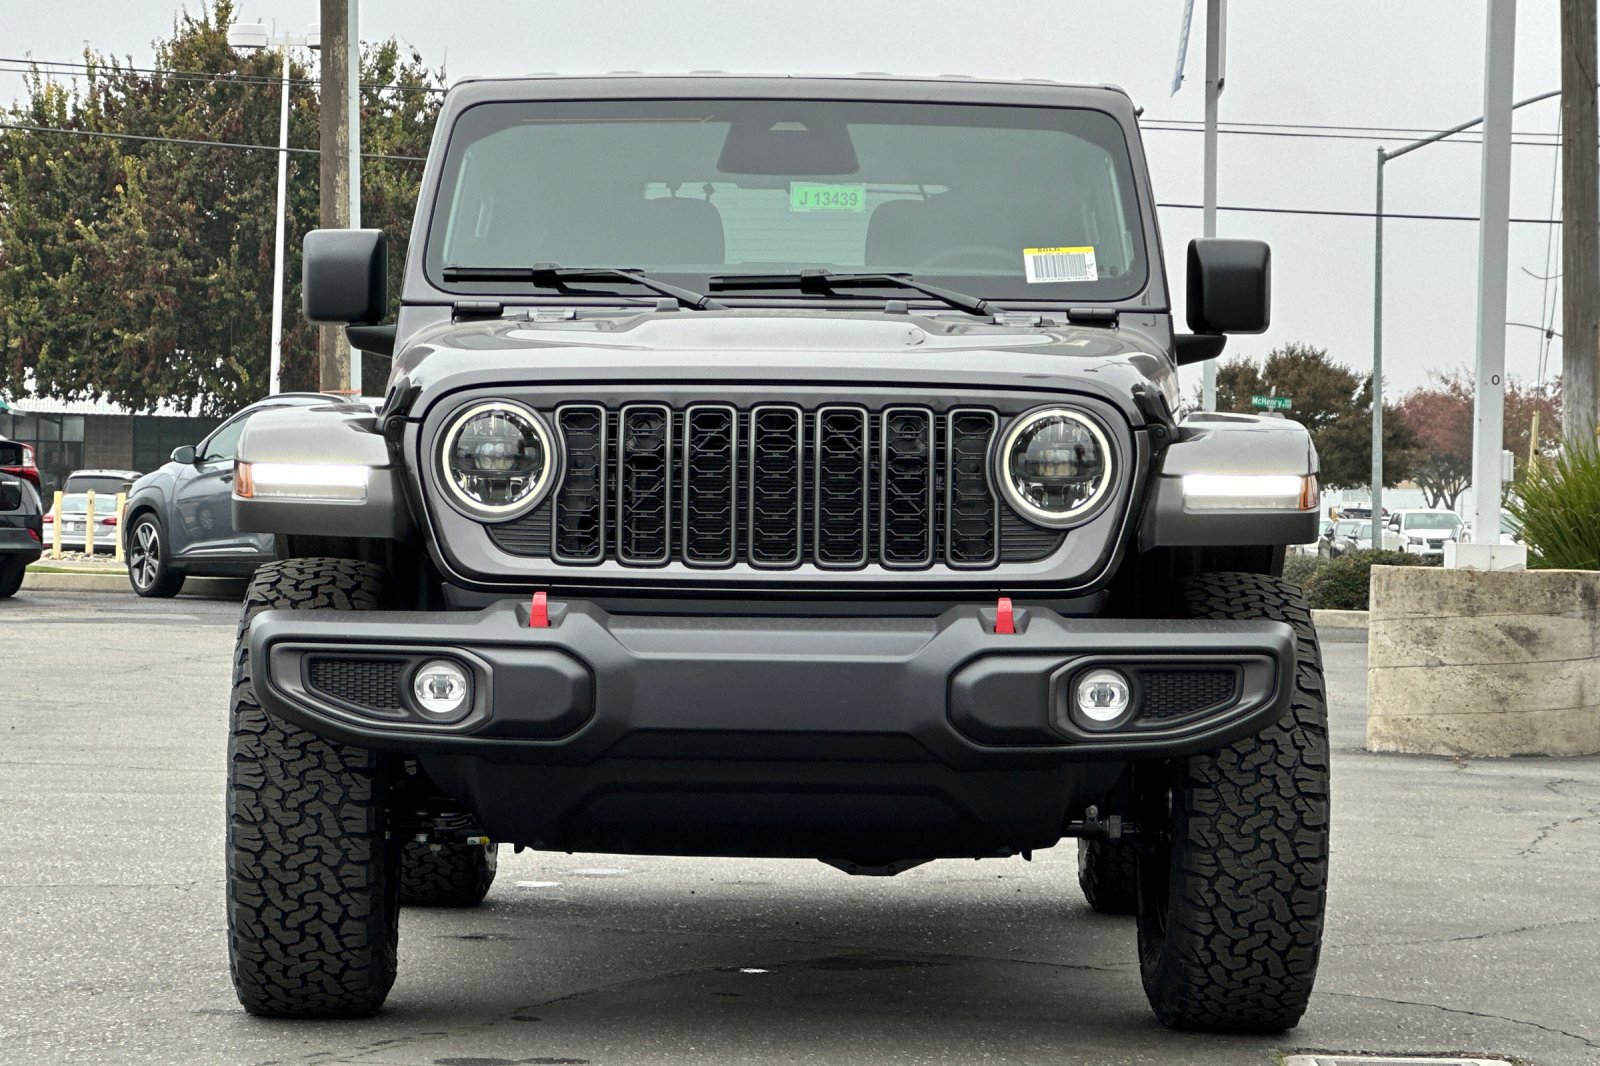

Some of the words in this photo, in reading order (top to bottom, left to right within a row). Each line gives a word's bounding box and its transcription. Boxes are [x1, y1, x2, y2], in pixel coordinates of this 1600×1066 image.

[799, 191, 808, 206] J
[813, 191, 858, 207] 13439
[1251, 396, 1283, 408] McHenry
